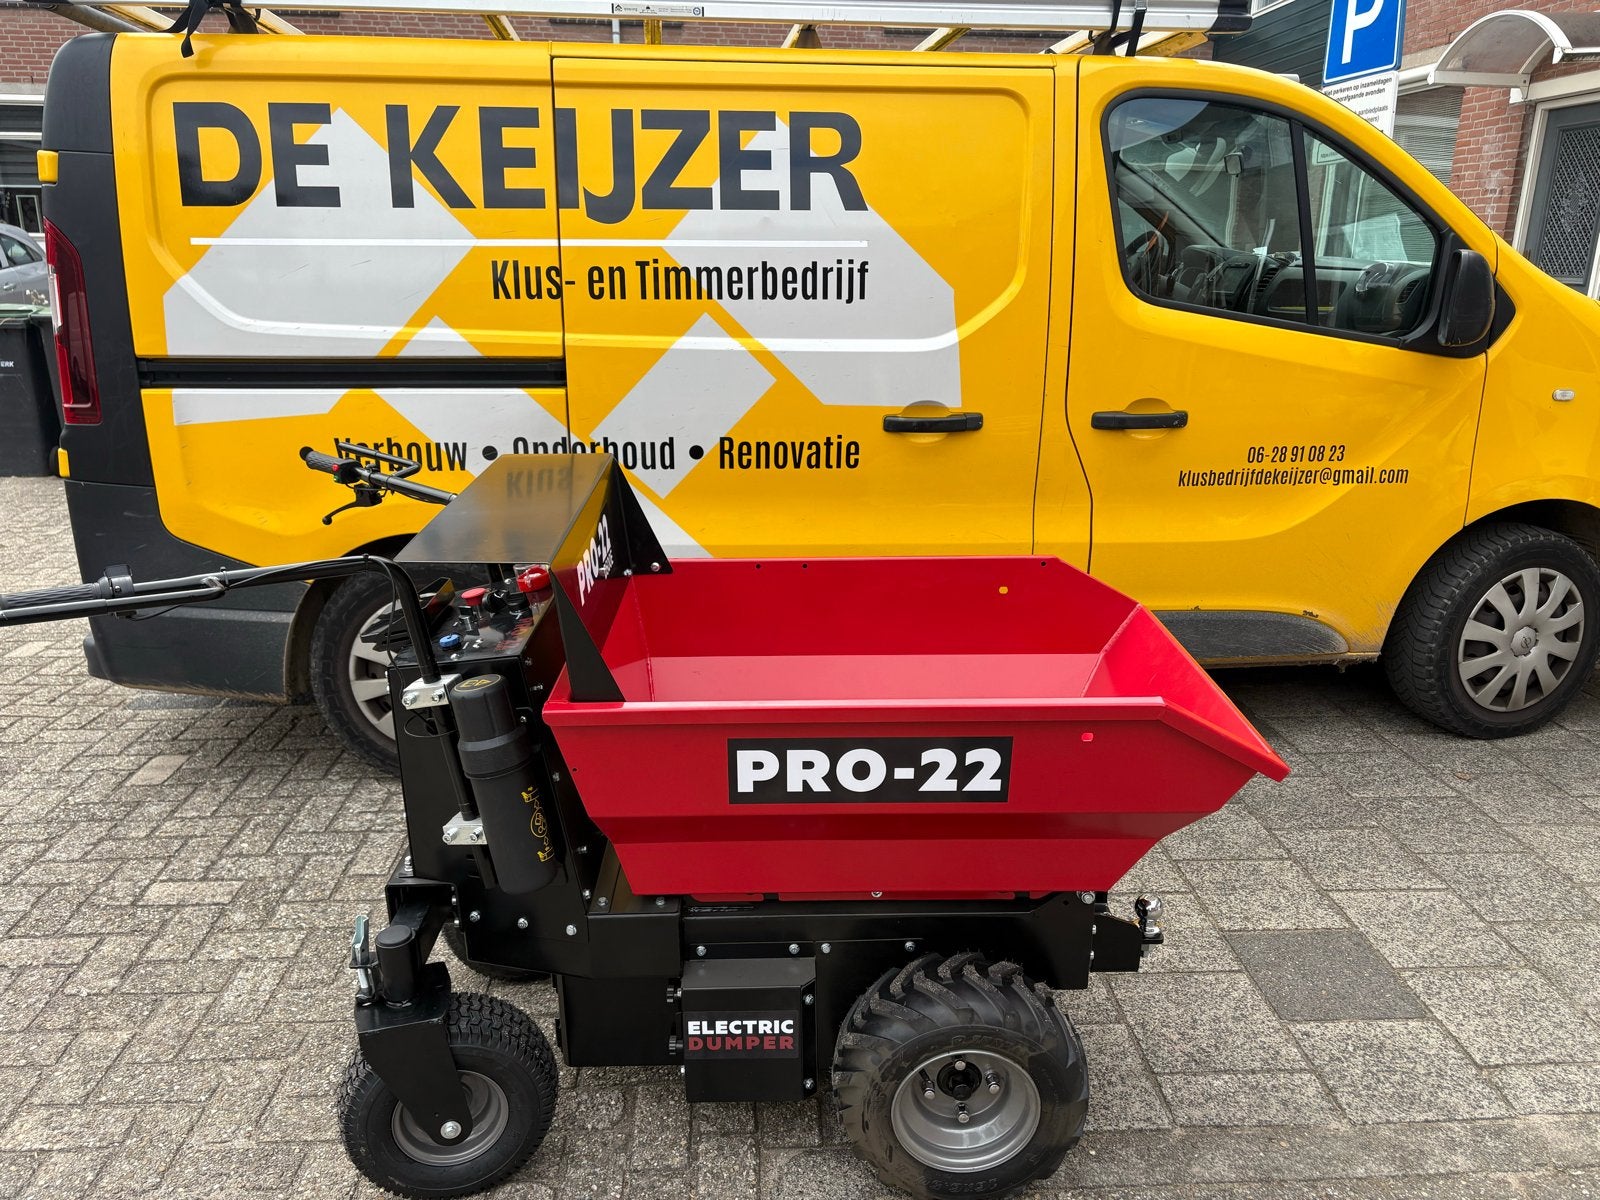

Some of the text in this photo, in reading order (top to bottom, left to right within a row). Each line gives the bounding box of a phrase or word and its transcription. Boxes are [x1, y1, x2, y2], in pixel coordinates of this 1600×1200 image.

[1341, 0, 1385, 65] P
[173, 101, 869, 224] DE KEIJZER
[491, 258, 869, 304] Klus- en Timmerbedrijf
[718, 435, 861, 470] Renovatie
[1247, 444, 1346, 463] 06-28 91 08 23
[1178, 466, 1409, 487] klusbedrijfdekeijzer@gmail.com
[577, 514, 612, 607] PRO-22
[736, 748, 1002, 793] PRO-22
[687, 1020, 794, 1035] ELECTRIC
[688, 1035, 794, 1051] DUMPER
